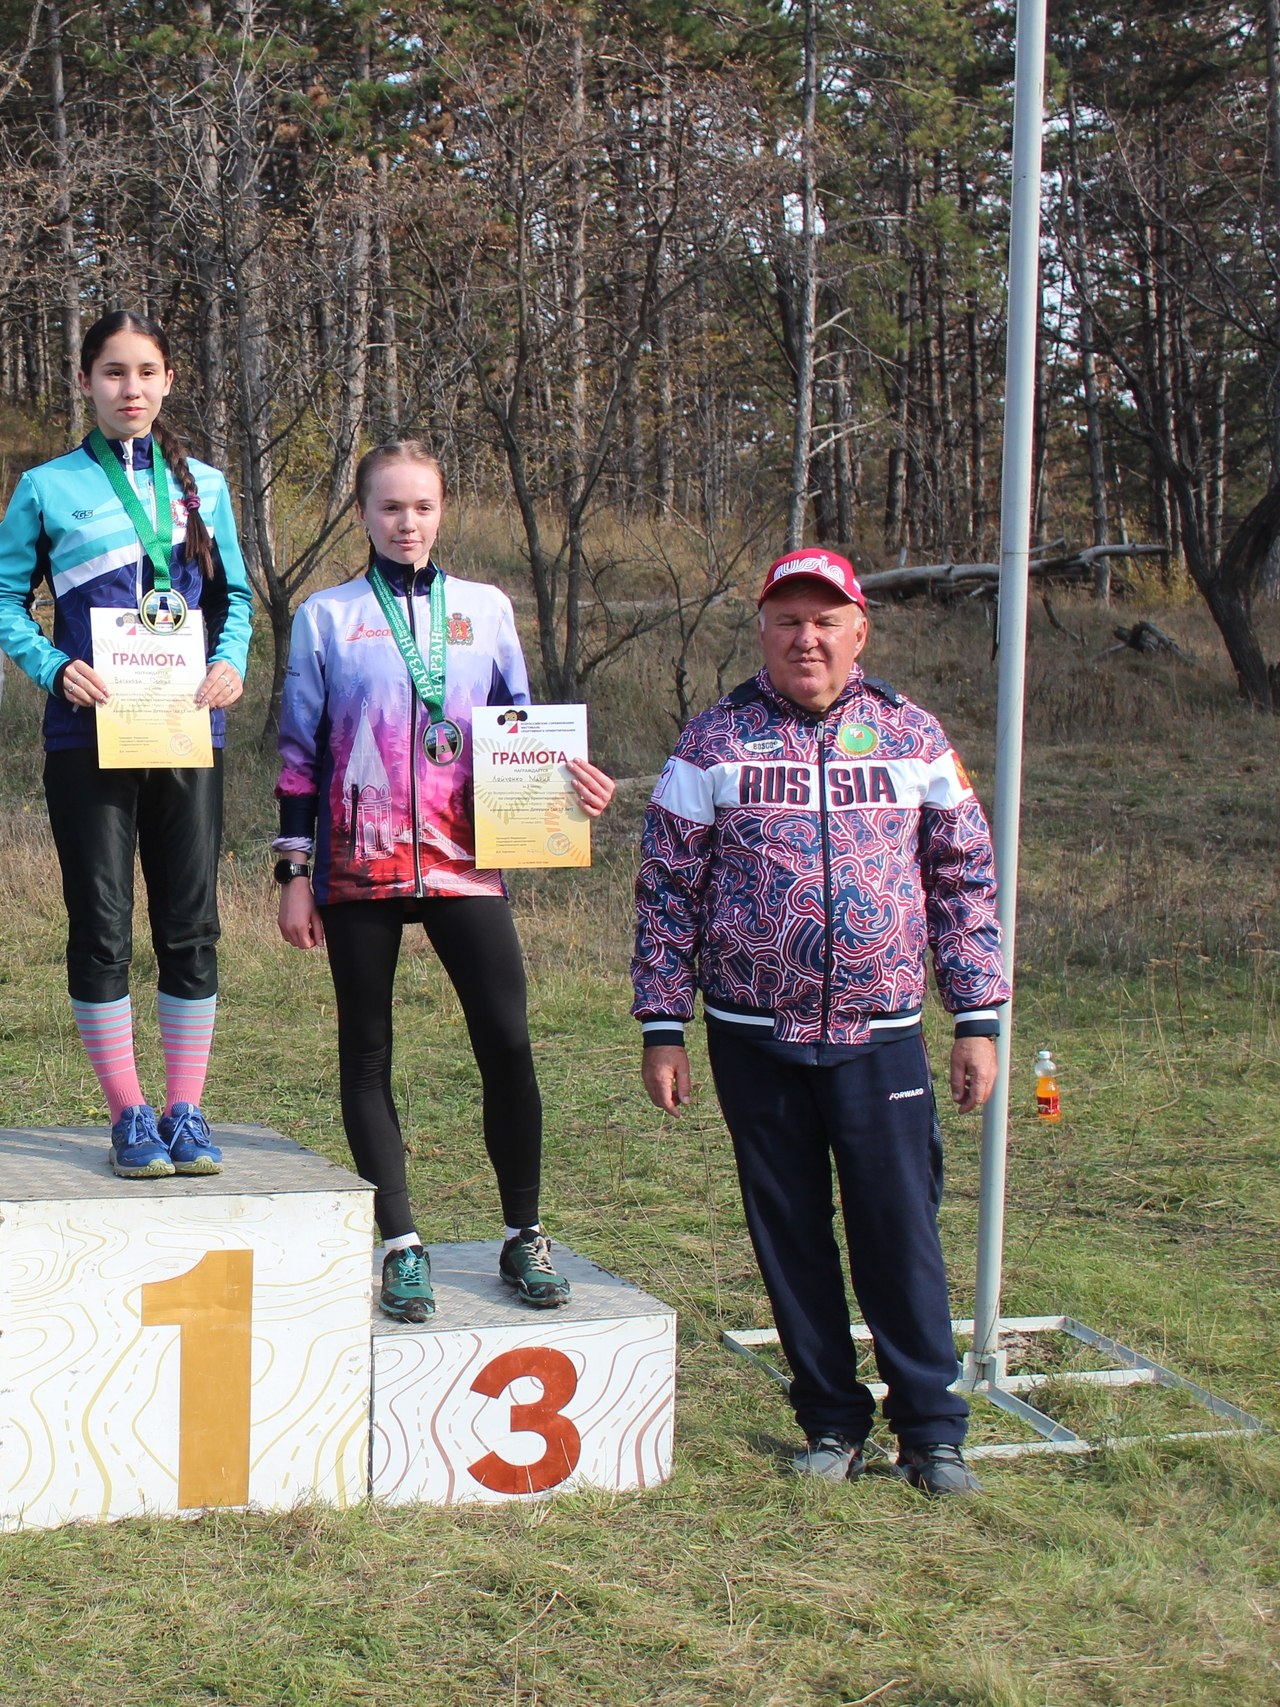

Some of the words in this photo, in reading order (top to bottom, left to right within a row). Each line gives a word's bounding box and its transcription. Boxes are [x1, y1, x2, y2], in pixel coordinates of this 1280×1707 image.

[112, 652, 186, 667] ГРАМОТА
[400, 635, 435, 699] НАРЗАН
[431, 631, 444, 696] НАРЗАН
[440, 744, 446, 753] 3
[492, 751, 568, 765] ГРАМОТА
[889, 1088, 924, 1100] FORWARD
[141, 1249, 255, 1510] 1
[467, 1347, 581, 1494] 3
